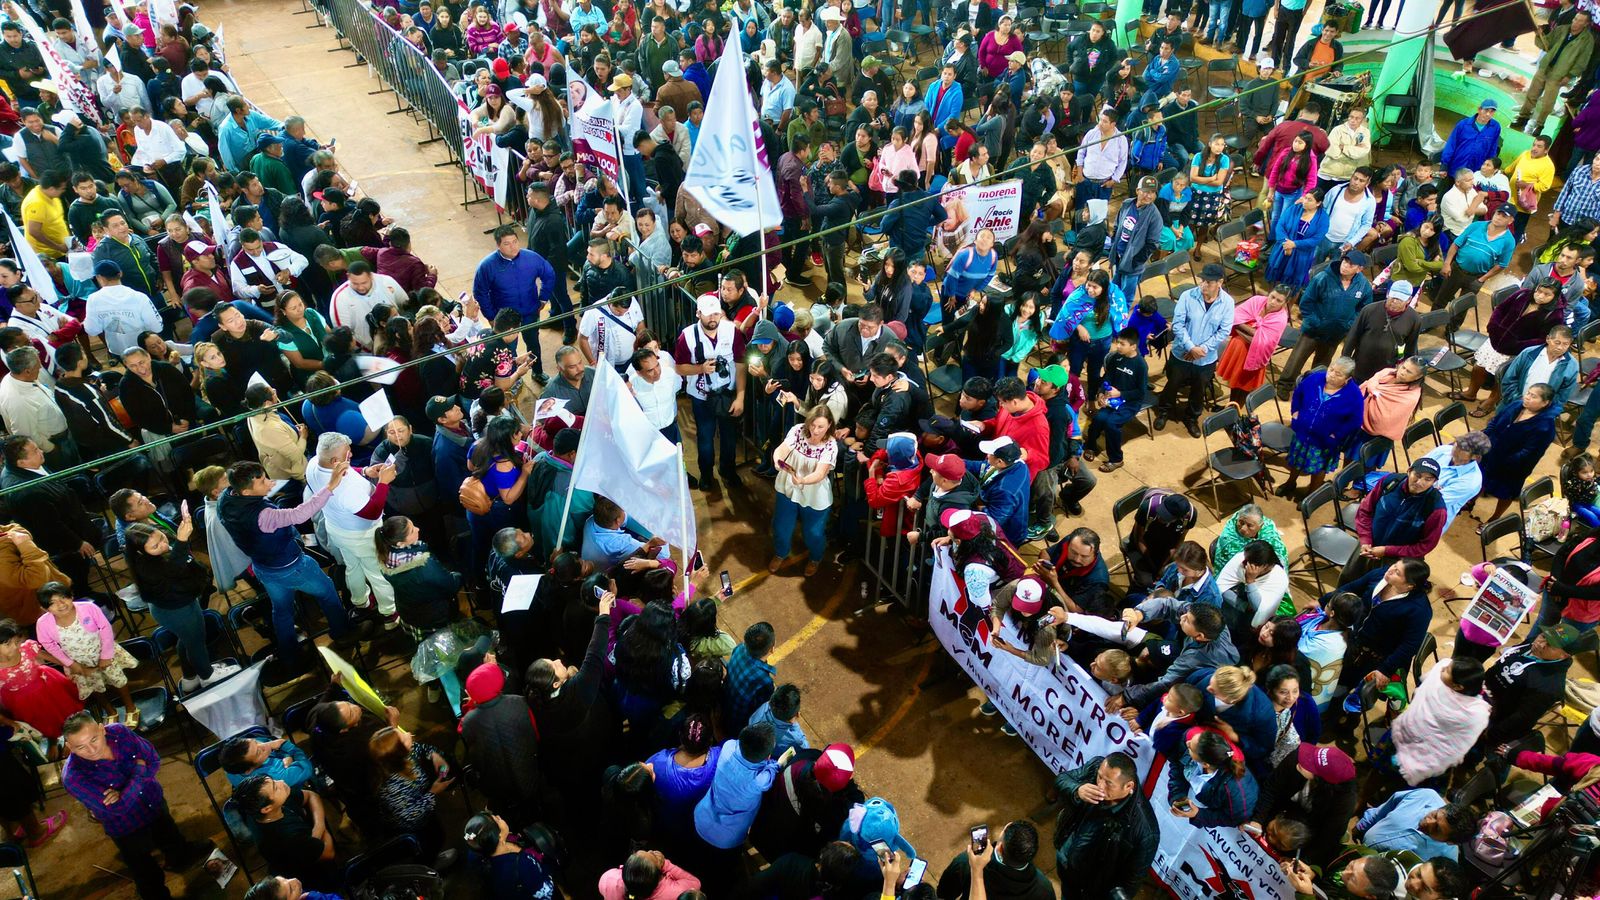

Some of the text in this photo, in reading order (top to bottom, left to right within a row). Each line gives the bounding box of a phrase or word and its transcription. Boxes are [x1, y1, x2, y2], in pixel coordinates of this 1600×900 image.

[978, 187, 1017, 199] morena
[974, 211, 1012, 228] Nahle
[993, 208, 1013, 216] Rocío
[1011, 683, 1085, 767] MOREN
[1045, 687, 1093, 746] CON
[1235, 834, 1287, 886] Zona Sur
